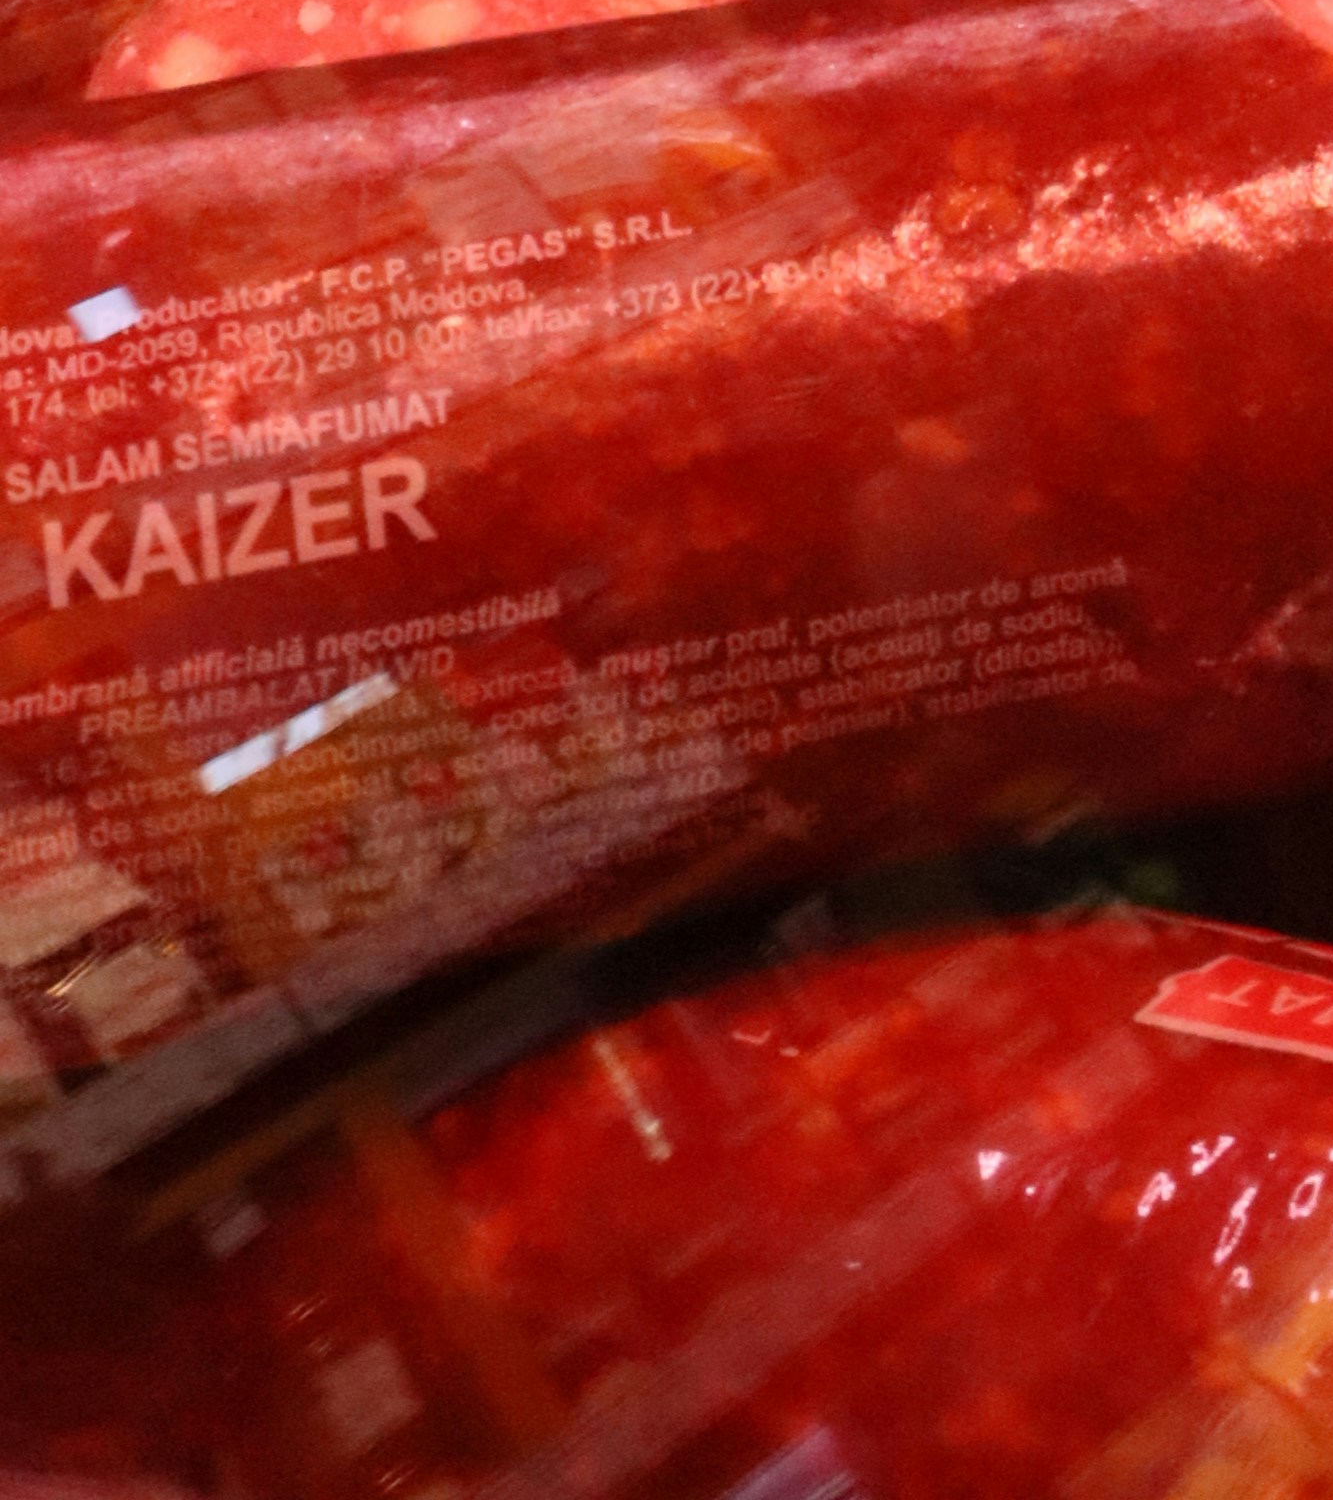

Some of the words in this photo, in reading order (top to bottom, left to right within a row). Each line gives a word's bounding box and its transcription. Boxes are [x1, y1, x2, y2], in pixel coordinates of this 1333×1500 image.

[593, 211, 694, 252] S.R.L.
[602, 277, 682, 320] +373
[218, 299, 382, 356] Republica
[5, 445, 162, 501] SALAM
[173, 388, 453, 472] SEMIAFUMAT
[42, 455, 438, 611] KAIZER
[979, 577, 1021, 608] de
[1031, 555, 1128, 600] aromă
[951, 618, 993, 647] de
[79, 666, 341, 743] PREAMBALAT
[395, 646, 456, 683] VID
